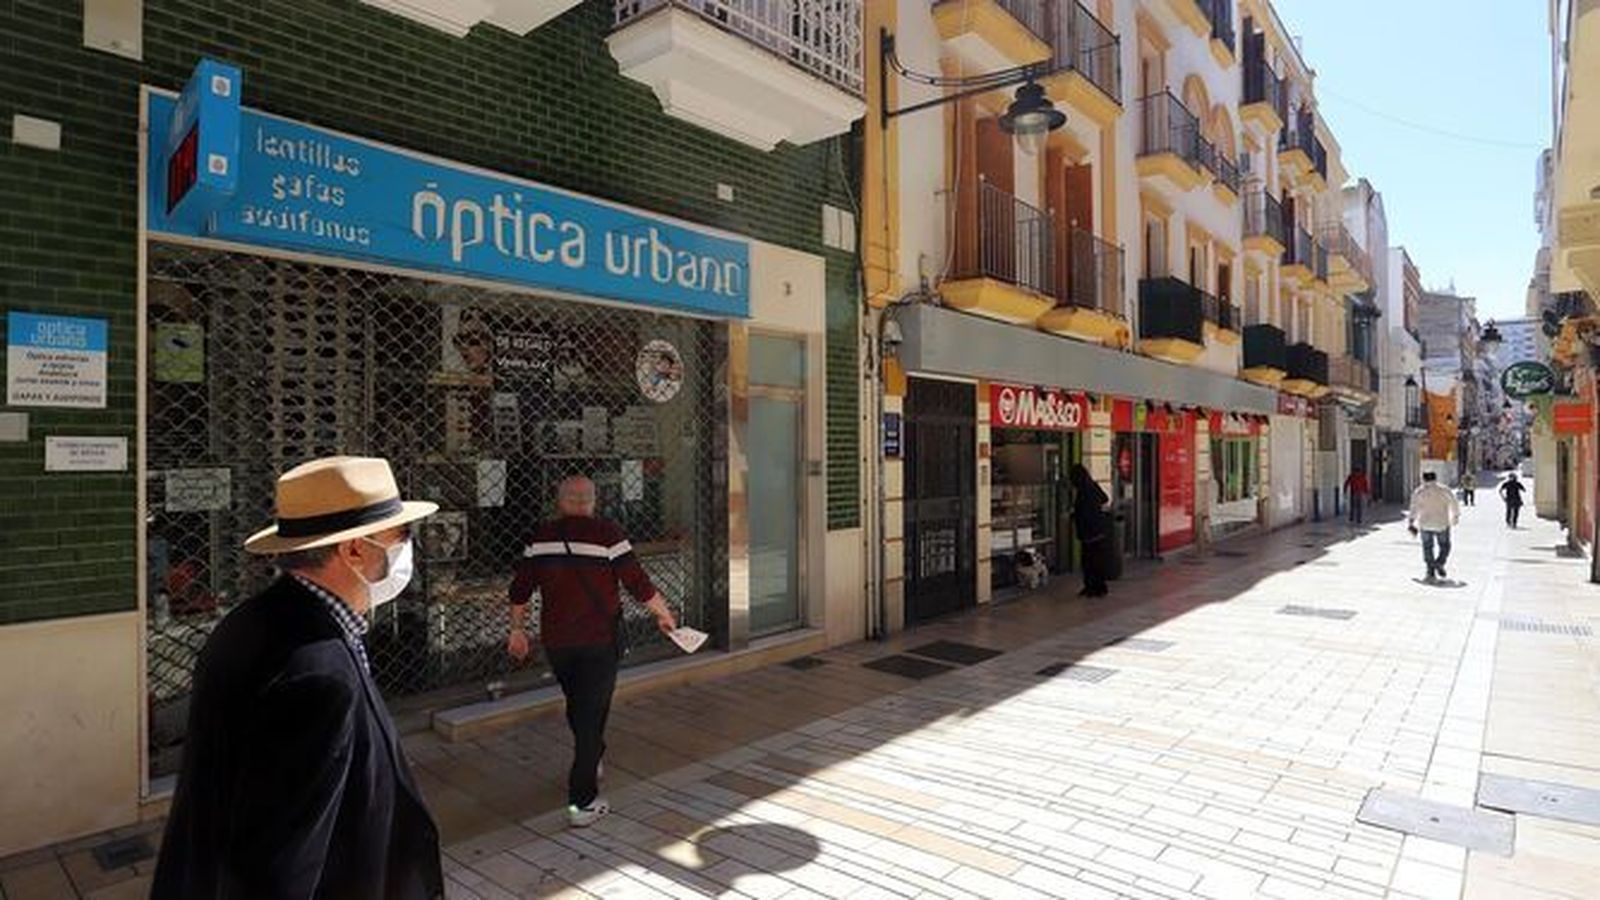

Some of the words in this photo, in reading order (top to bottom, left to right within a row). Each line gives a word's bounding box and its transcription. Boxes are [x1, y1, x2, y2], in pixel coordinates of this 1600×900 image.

[257, 126, 361, 175] lentillas
[272, 174, 345, 206] gafas
[411, 182, 587, 268] óptica
[605, 227, 742, 297] urbano
